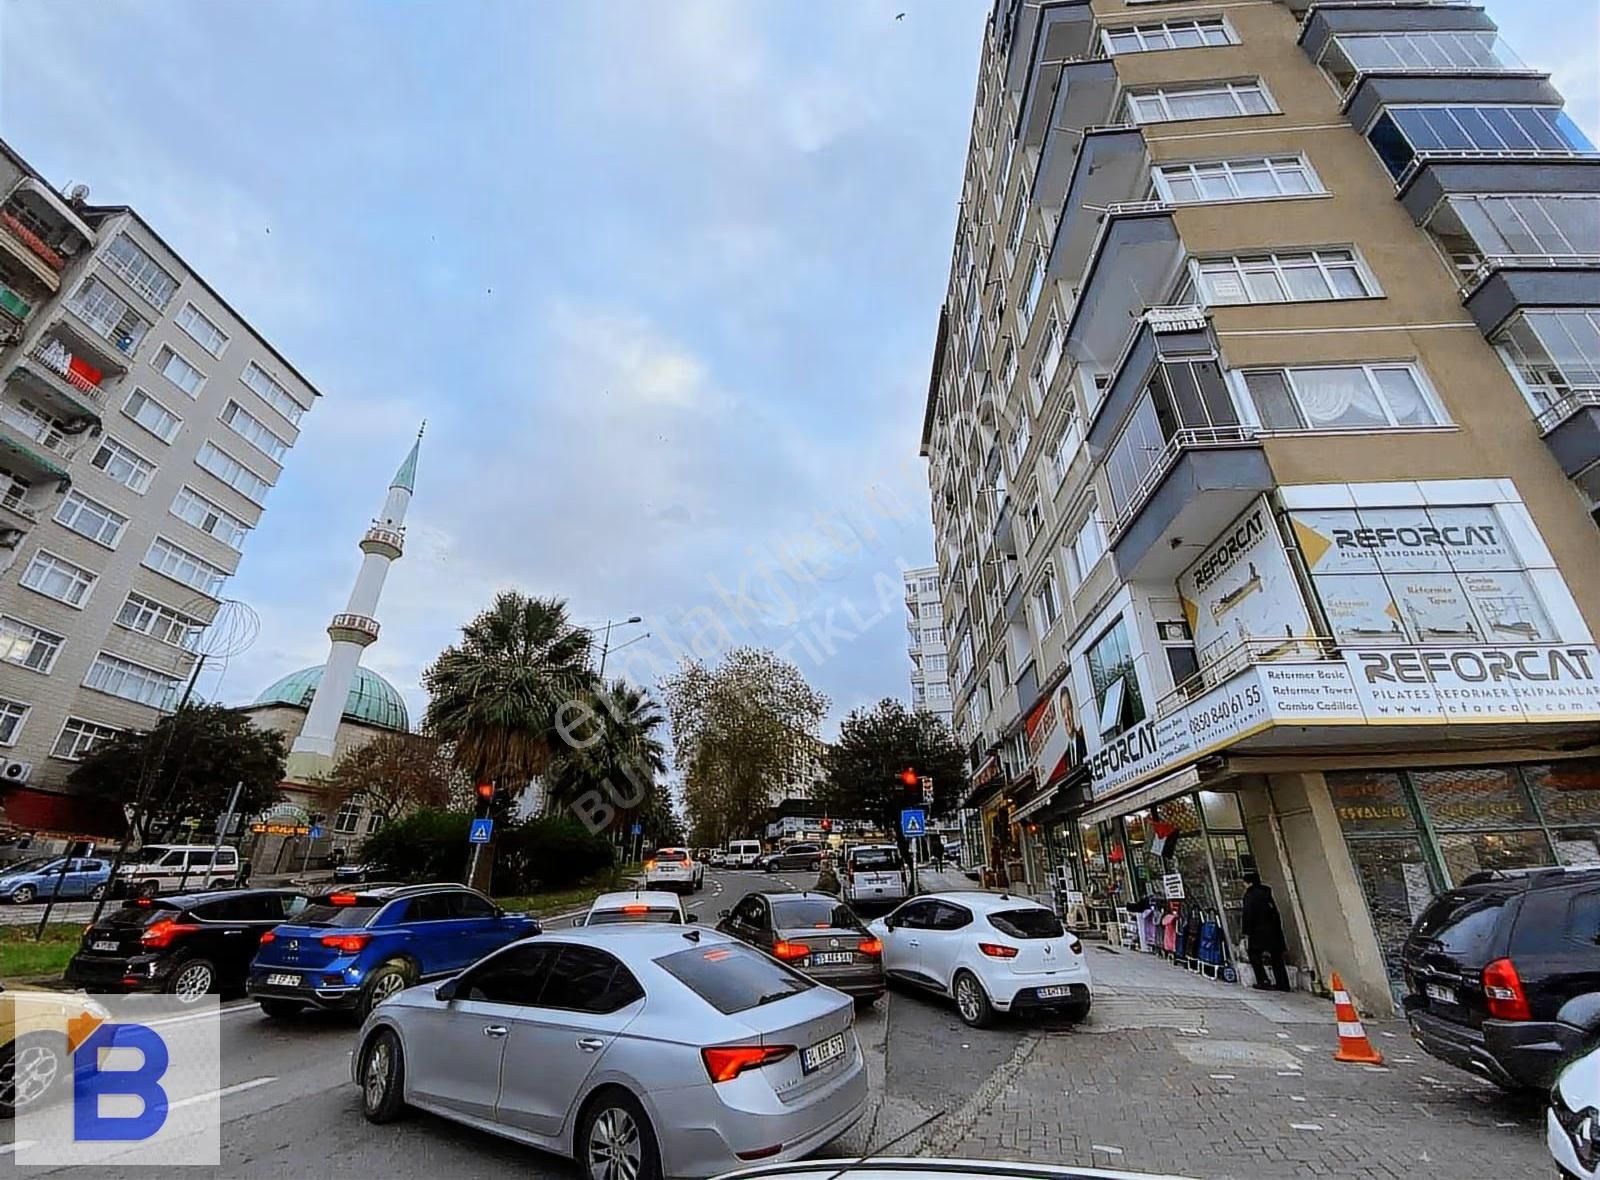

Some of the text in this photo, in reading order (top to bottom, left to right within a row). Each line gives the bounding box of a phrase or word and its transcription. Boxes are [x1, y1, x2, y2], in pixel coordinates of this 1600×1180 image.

[1194, 510, 1263, 589] REFORCAT
[1332, 526, 1497, 549] REFORCAT
[1359, 649, 1593, 684] REFORCAT
[1245, 684, 1261, 707] 55
